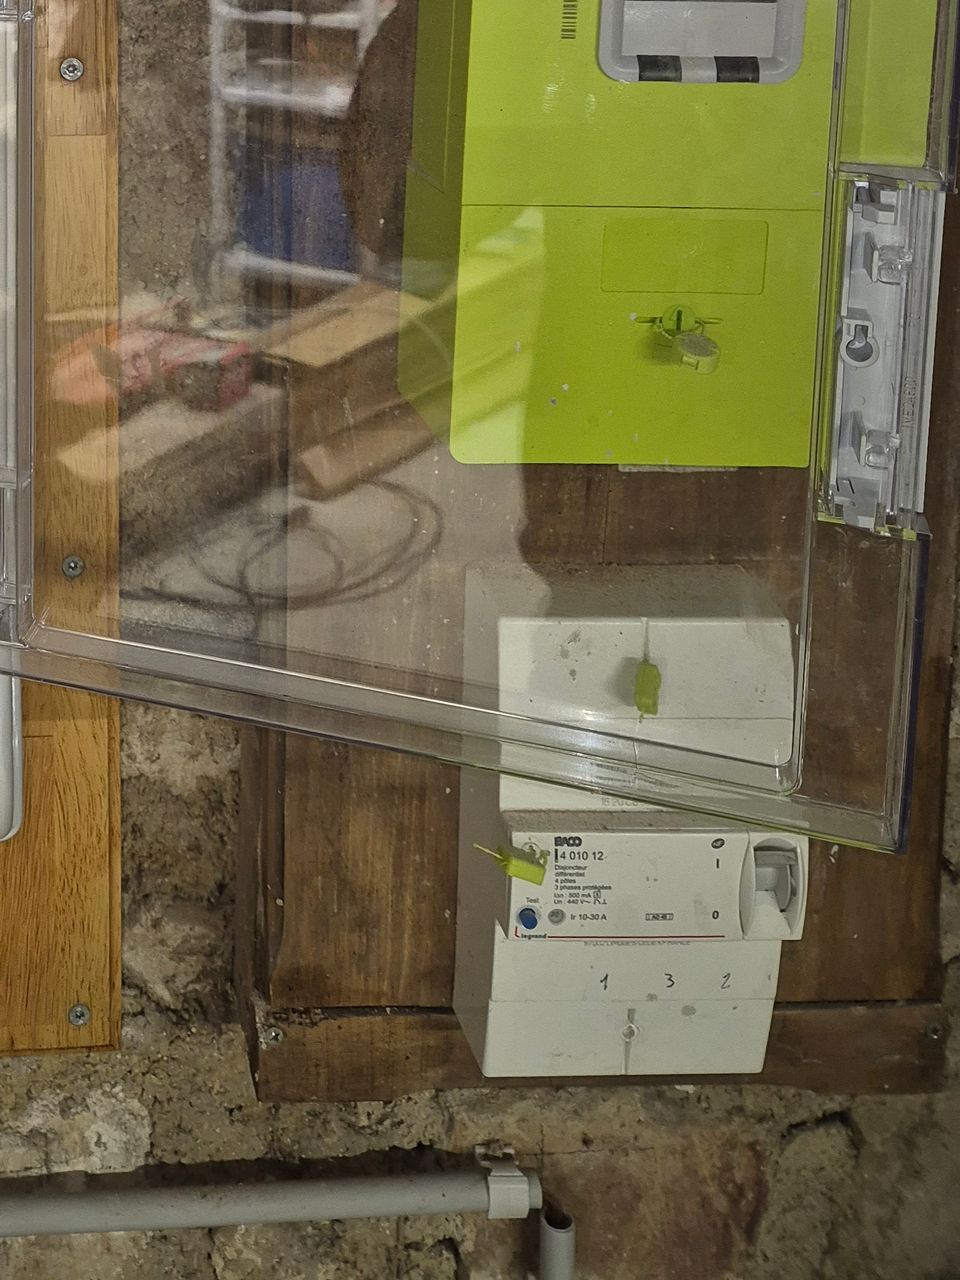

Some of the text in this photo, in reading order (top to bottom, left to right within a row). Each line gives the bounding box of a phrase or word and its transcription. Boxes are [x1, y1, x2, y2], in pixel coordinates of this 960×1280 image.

[569, 851, 588, 860] 010
[592, 851, 604, 860] 12
[600, 972, 731, 991] 1 3 2
